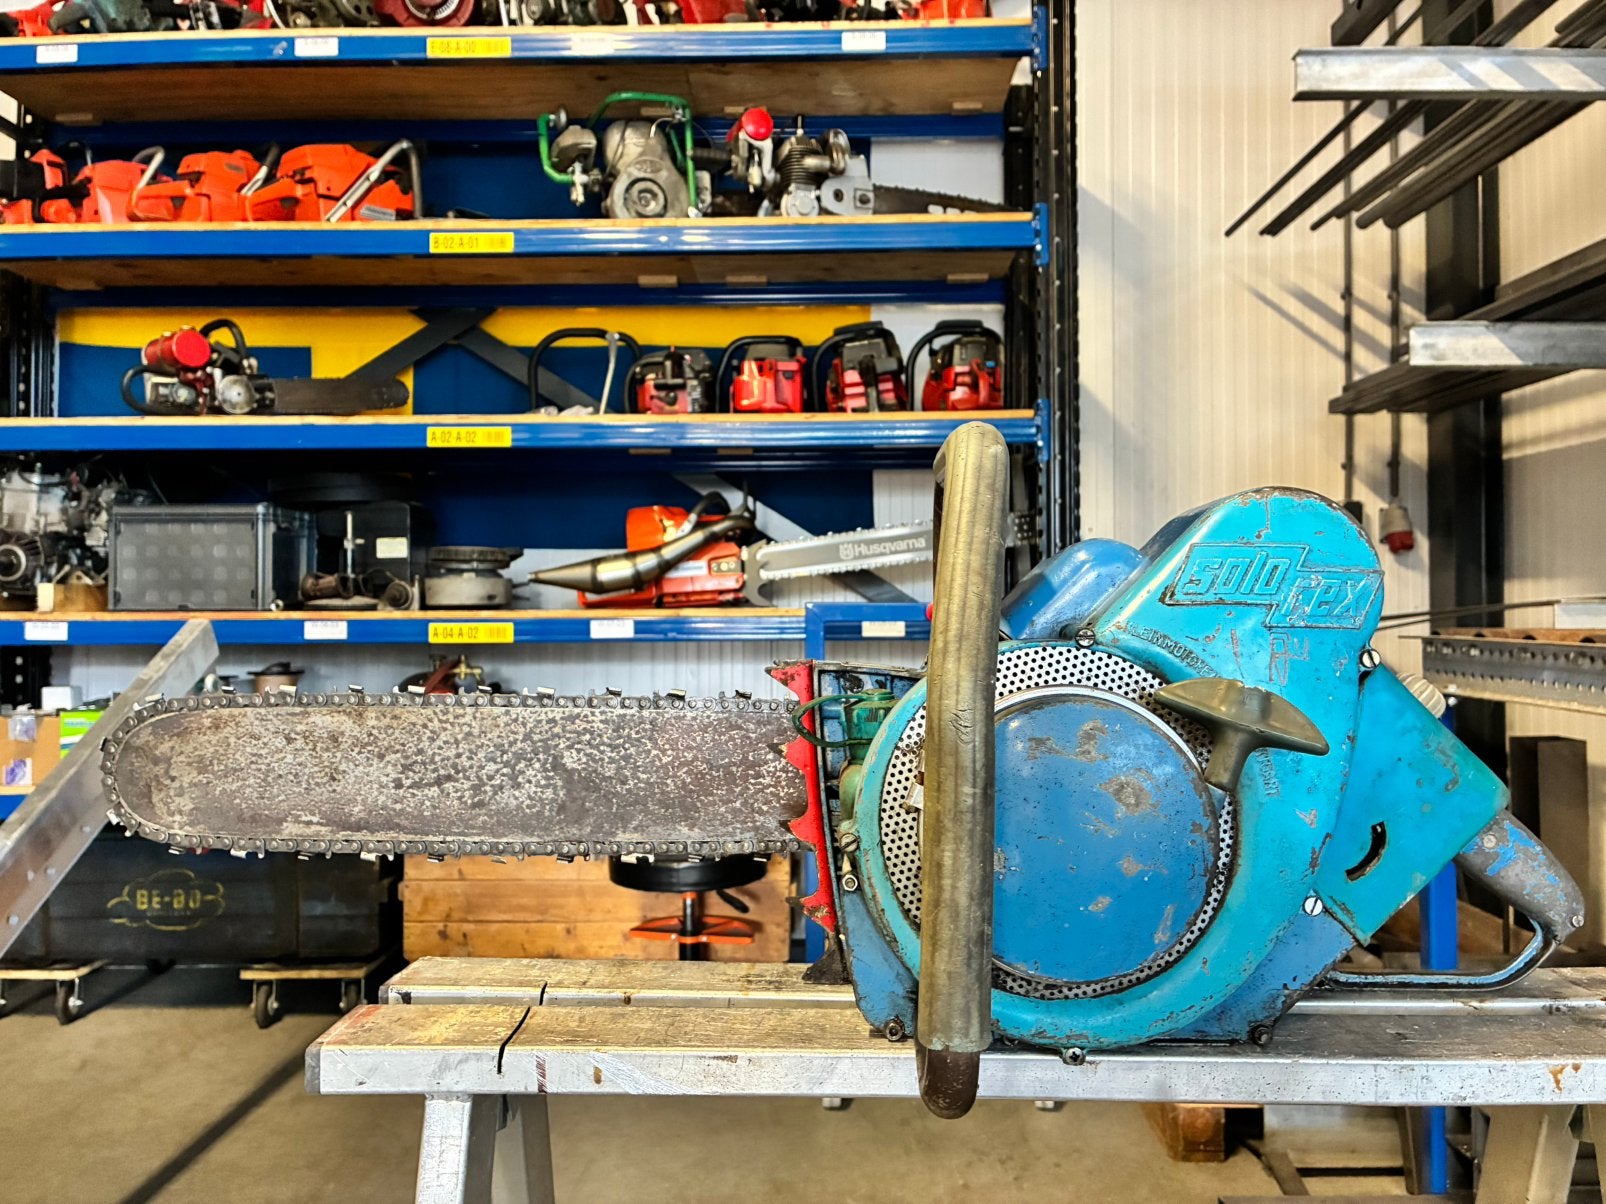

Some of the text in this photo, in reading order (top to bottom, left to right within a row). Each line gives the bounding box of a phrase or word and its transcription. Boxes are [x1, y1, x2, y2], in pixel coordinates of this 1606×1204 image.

[854, 537, 926, 557] Husqvarna
[1182, 550, 1293, 596] solo
[1280, 573, 1371, 617] rex
